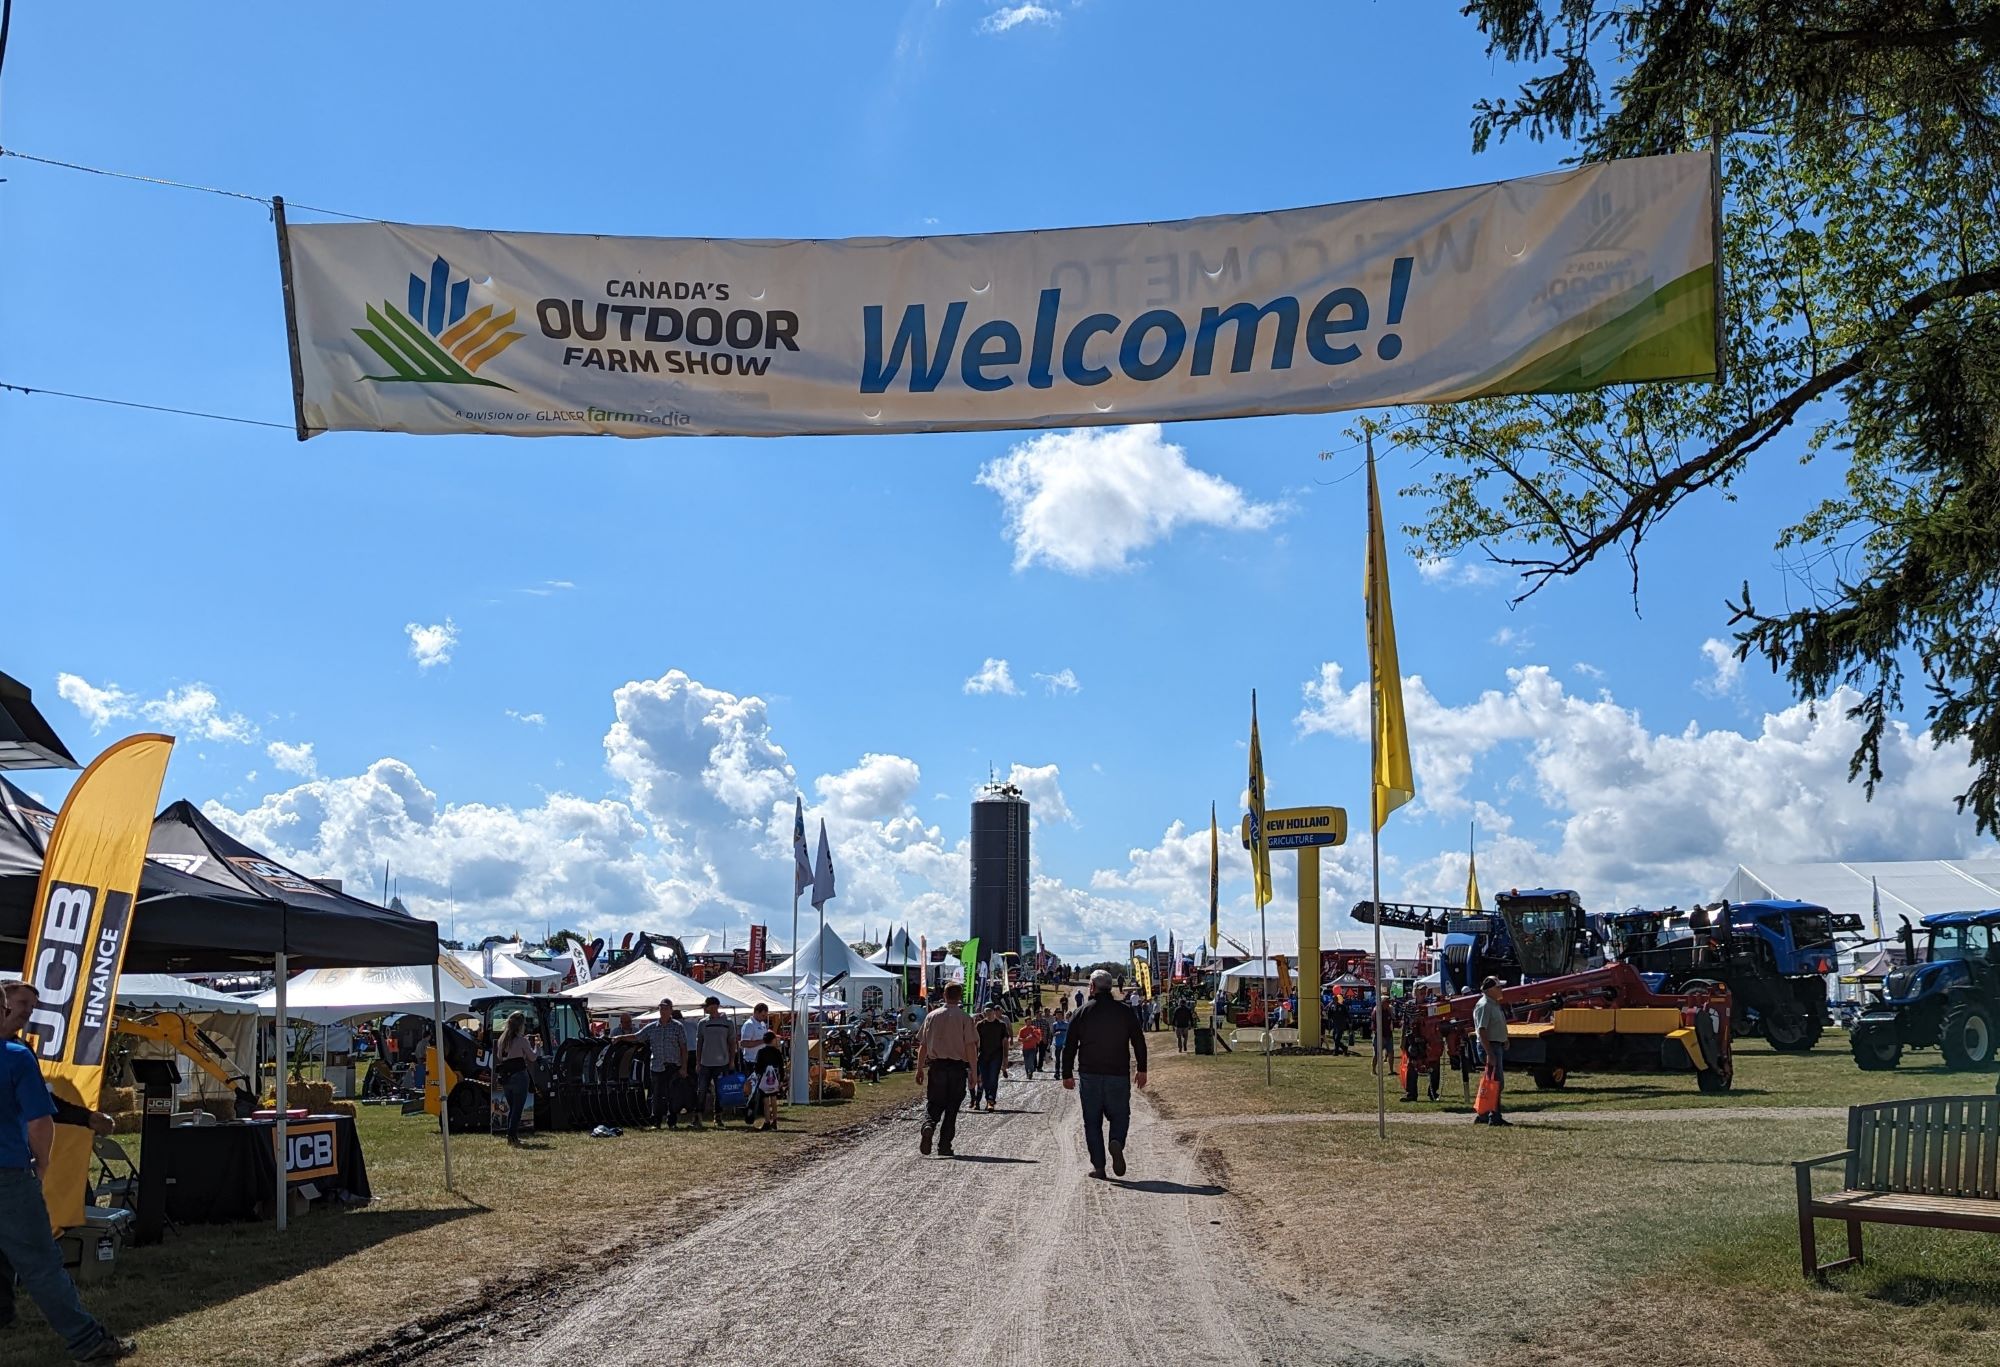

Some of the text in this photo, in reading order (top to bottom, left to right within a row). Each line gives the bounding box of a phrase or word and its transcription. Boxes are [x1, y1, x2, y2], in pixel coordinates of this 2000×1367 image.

[605, 279, 729, 302] CANADA'S
[535, 297, 801, 352] OUTDOOR
[859, 257, 1415, 393] Welcome!
[562, 347, 772, 376] FARM SHOW
[455, 409, 462, 418] A
[465, 410, 514, 421] DIVISION
[516, 412, 531, 421] OF
[536, 410, 585, 422] GLACIER
[1286, 816, 1330, 829] HOLLAND
[1268, 834, 1314, 846] GRICULTURE
[29, 887, 92, 1057] JCB
[84, 928, 119, 1028] FINANCE
[148, 1099, 171, 1107] JCB
[284, 1134, 333, 1170] JCB
